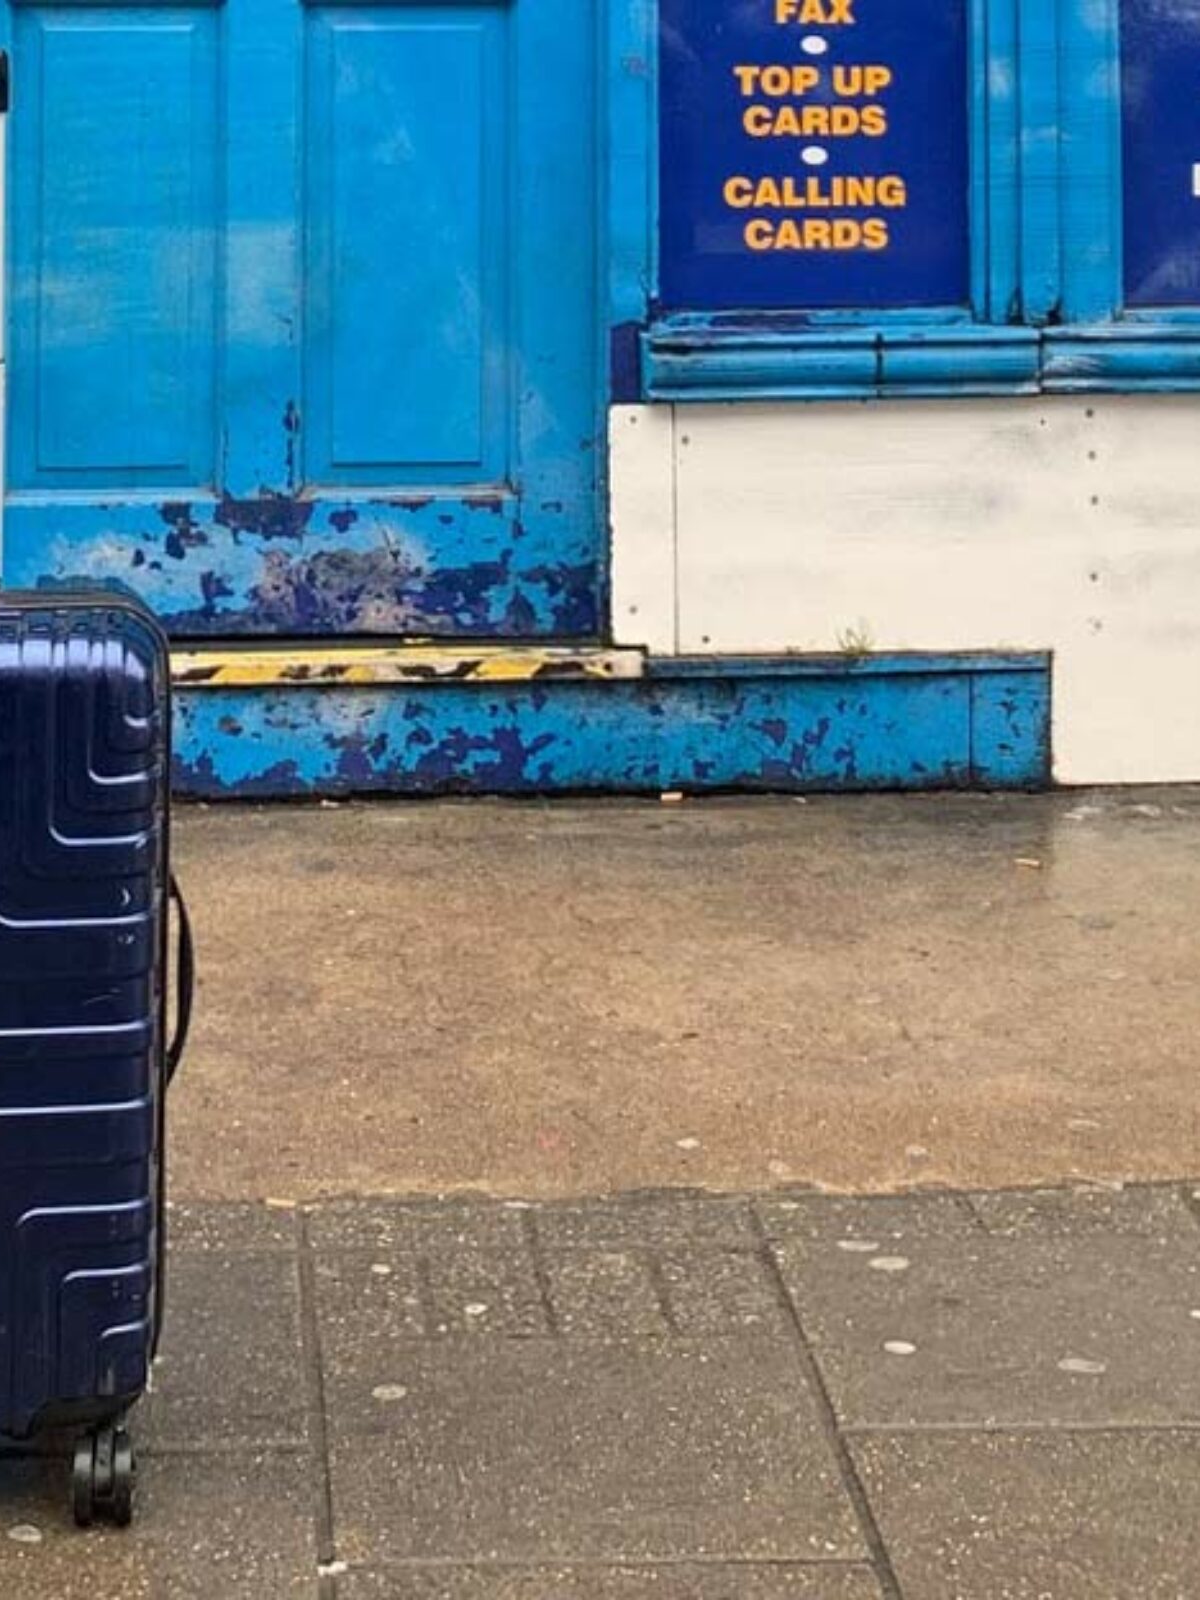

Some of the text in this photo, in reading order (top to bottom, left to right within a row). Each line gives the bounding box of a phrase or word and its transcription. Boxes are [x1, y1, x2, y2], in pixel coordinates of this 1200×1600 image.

[774, 0, 856, 24] FAX
[733, 66, 891, 96] TOP UP
[743, 105, 887, 137] CARDS
[723, 176, 906, 207] CALLING
[744, 218, 889, 250] CARDS
